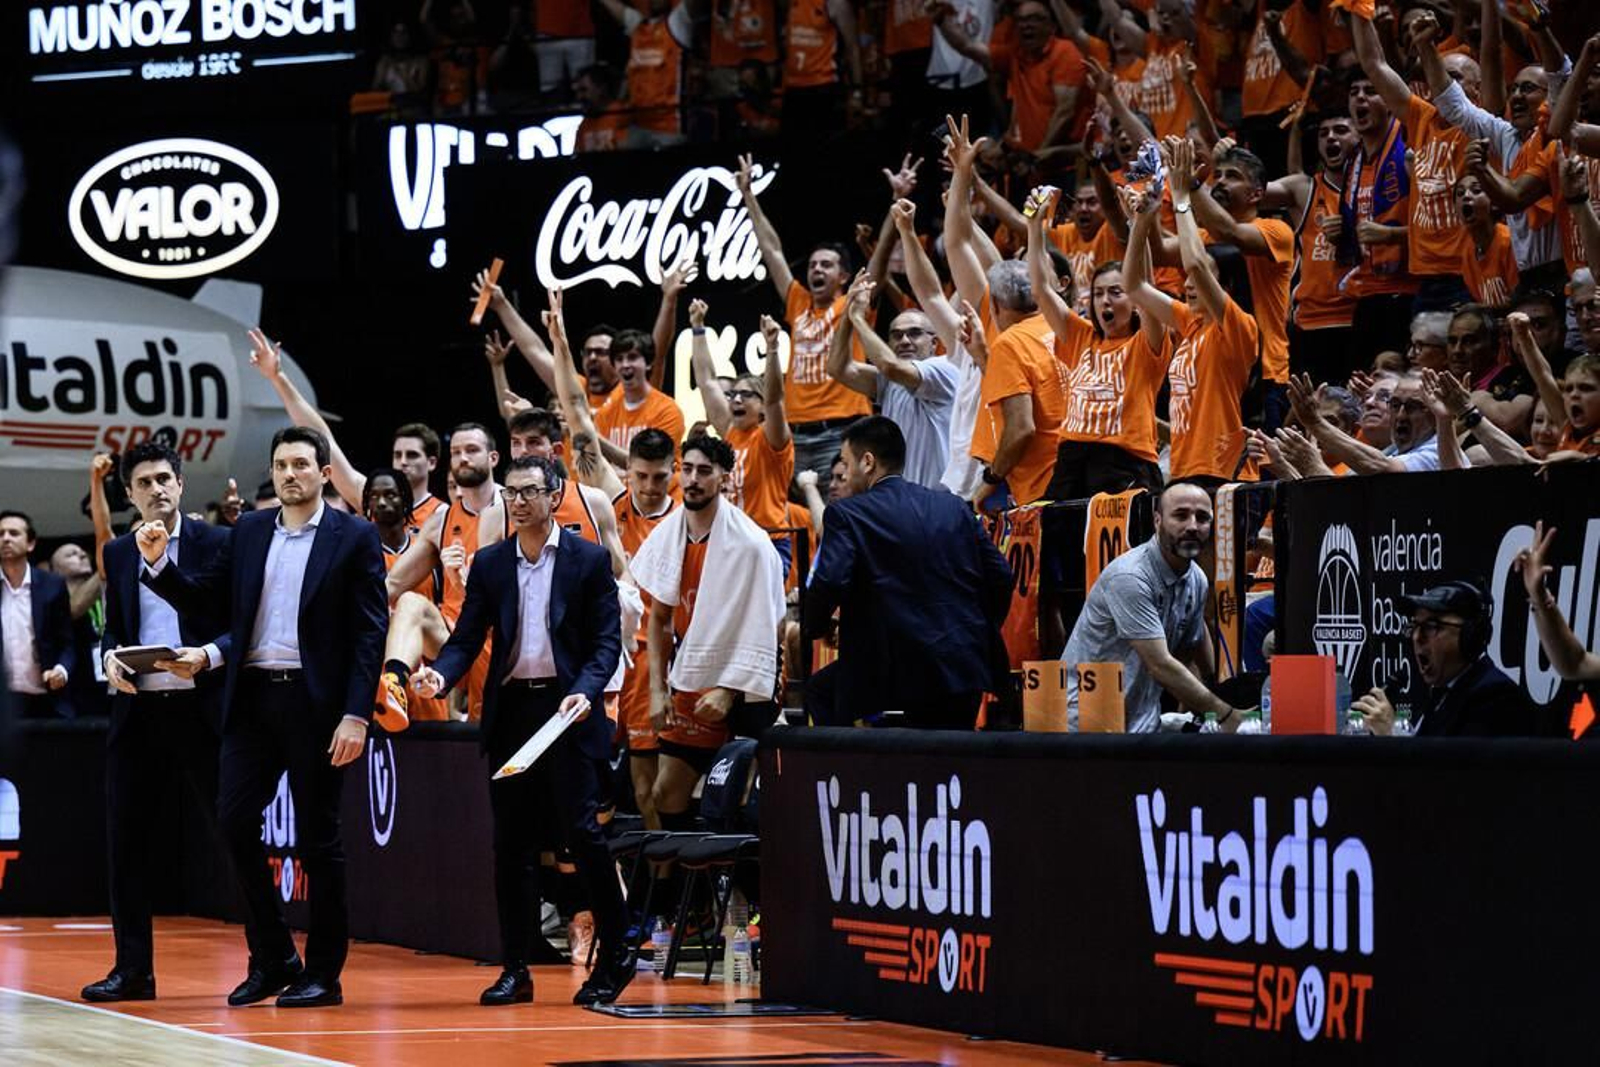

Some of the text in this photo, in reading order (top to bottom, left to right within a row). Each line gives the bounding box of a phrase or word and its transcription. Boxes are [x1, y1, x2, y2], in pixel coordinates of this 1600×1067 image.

[29, 0, 355, 53] MUÑOZ BOSCH
[120, 154, 220, 180] CHOCOLATES
[90, 182, 256, 242] VALOR
[535, 163, 780, 291] Coca-Cola
[1371, 519, 1442, 571] valencia
[1316, 628, 1363, 640] VALENCIA BASKET
[1372, 642, 1411, 694] club
[817, 774, 992, 919] Vitaldin
[1136, 786, 1374, 955] Vitaldin
[908, 927, 991, 993] SPORT
[1255, 965, 1373, 1042] SPORT
